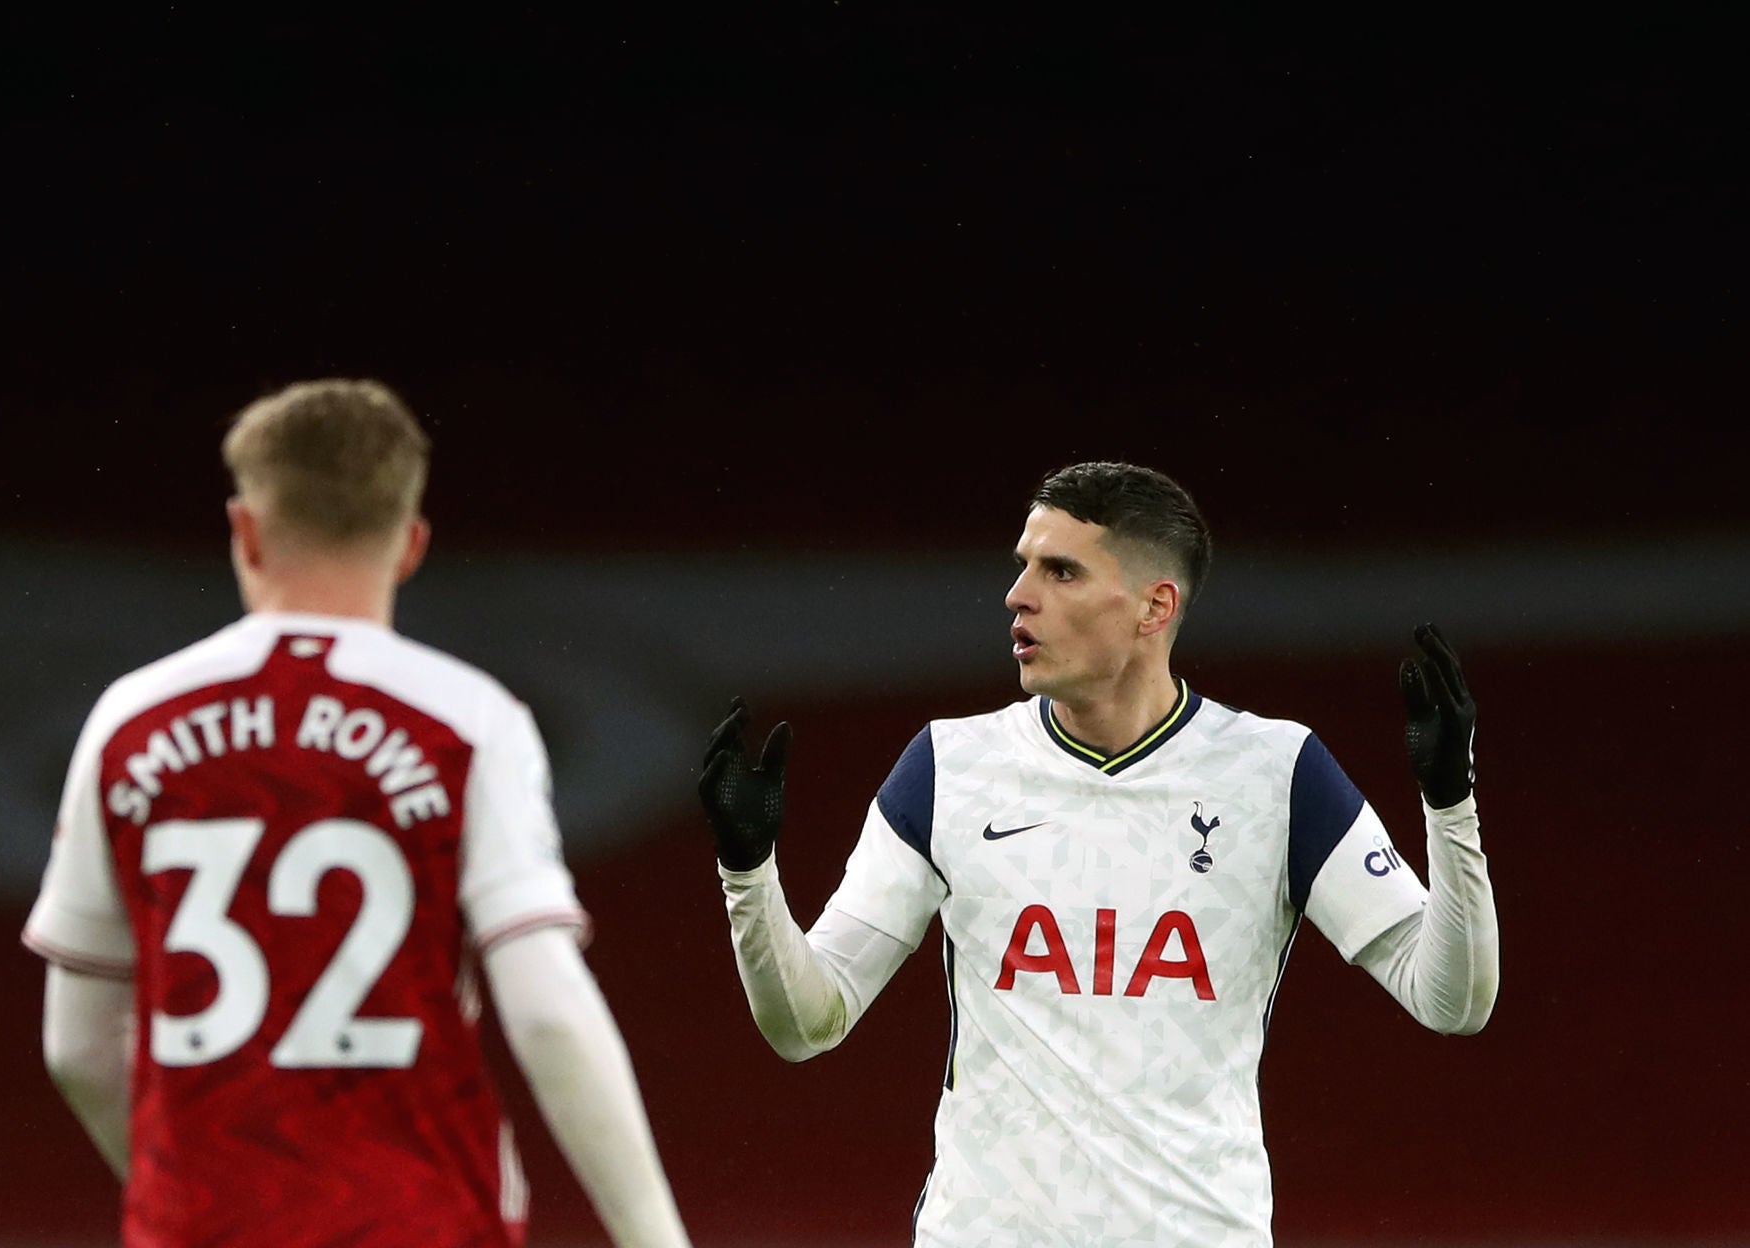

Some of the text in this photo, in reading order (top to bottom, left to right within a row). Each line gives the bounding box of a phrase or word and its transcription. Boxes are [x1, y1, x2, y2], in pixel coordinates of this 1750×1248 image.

[108, 693, 452, 829] SMITH ROWE
[141, 817, 424, 1069] 32
[994, 904, 1217, 1001] AIA
